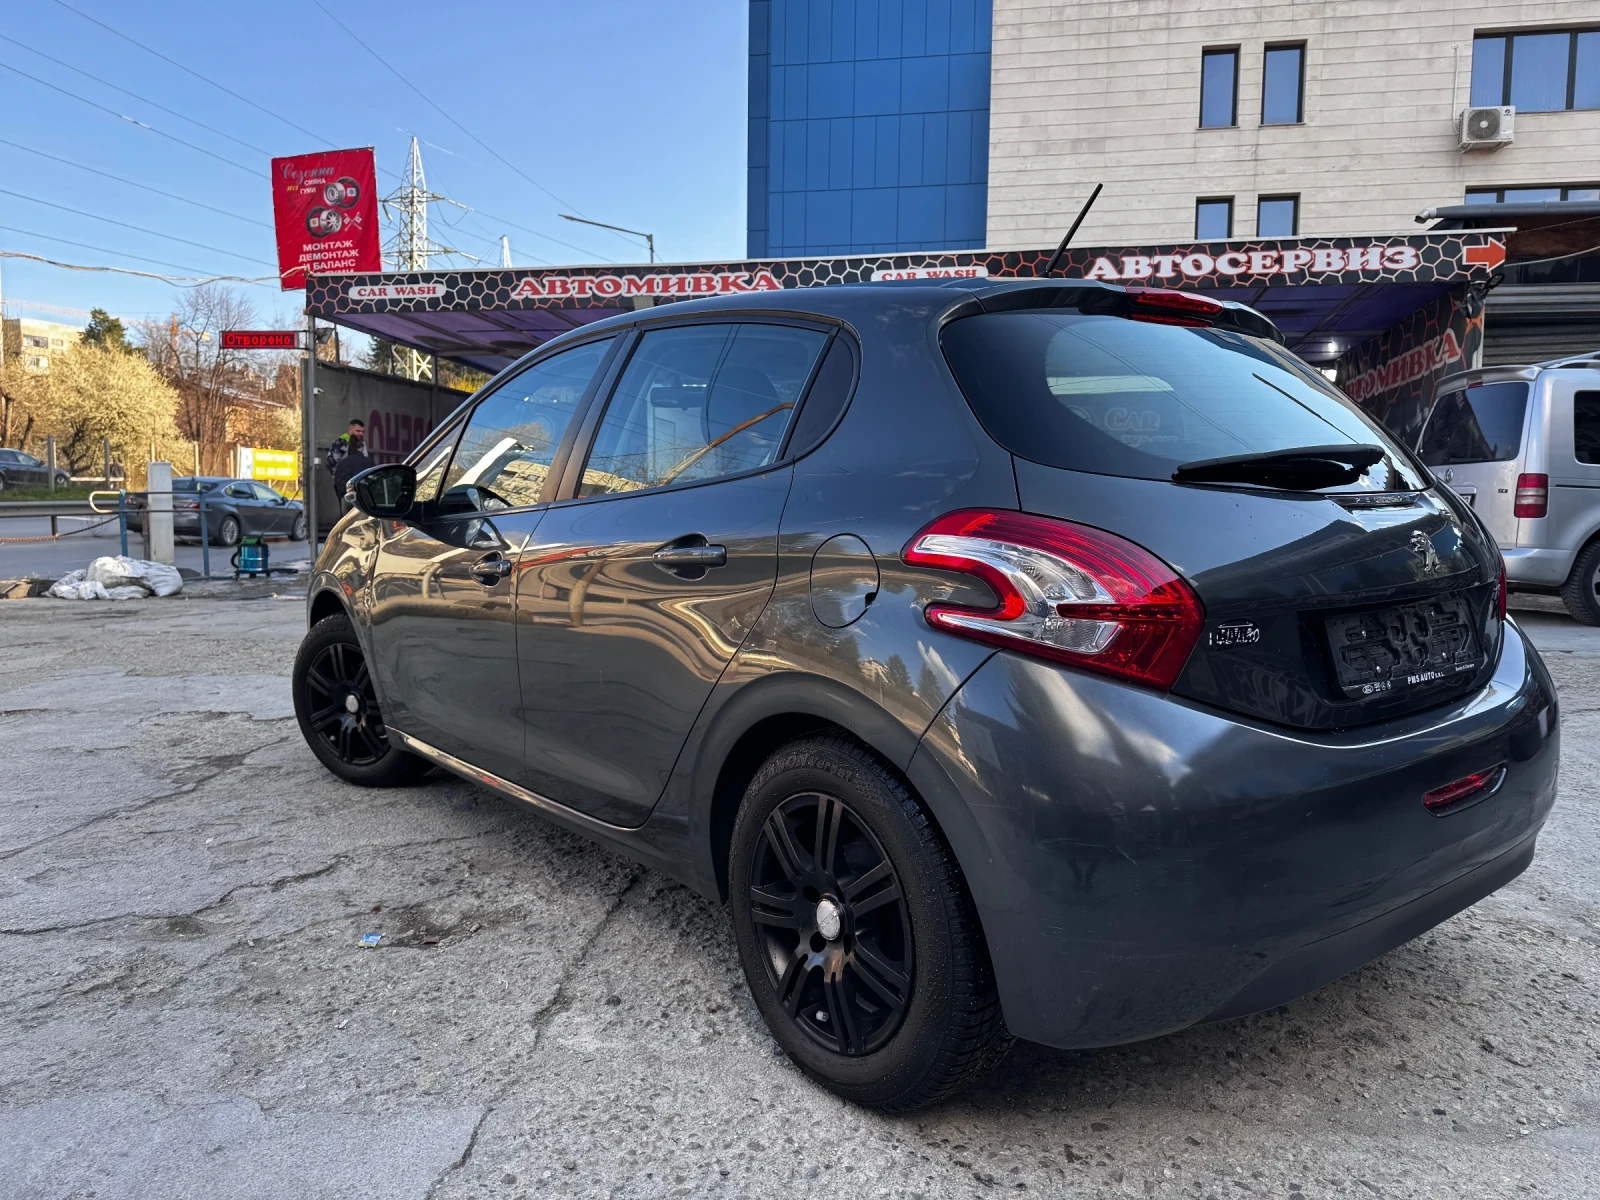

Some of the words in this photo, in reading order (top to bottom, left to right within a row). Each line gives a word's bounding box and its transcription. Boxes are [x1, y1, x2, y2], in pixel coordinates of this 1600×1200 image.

[303, 240, 353, 252] МОНТАЖ
[299, 249, 359, 263] ДЕМОНТАЖ
[313, 259, 356, 270] БАЛАНС
[1084, 246, 1419, 281] АВТОСЕРВИЗ
[925, 269, 978, 279] WASH
[512, 271, 784, 298] АВТОМИВКА
[357, 287, 388, 297] CAR
[394, 286, 437, 296] WASH
[226, 333, 291, 346] Отворено
[1420, 671, 1435, 682] AUTO
